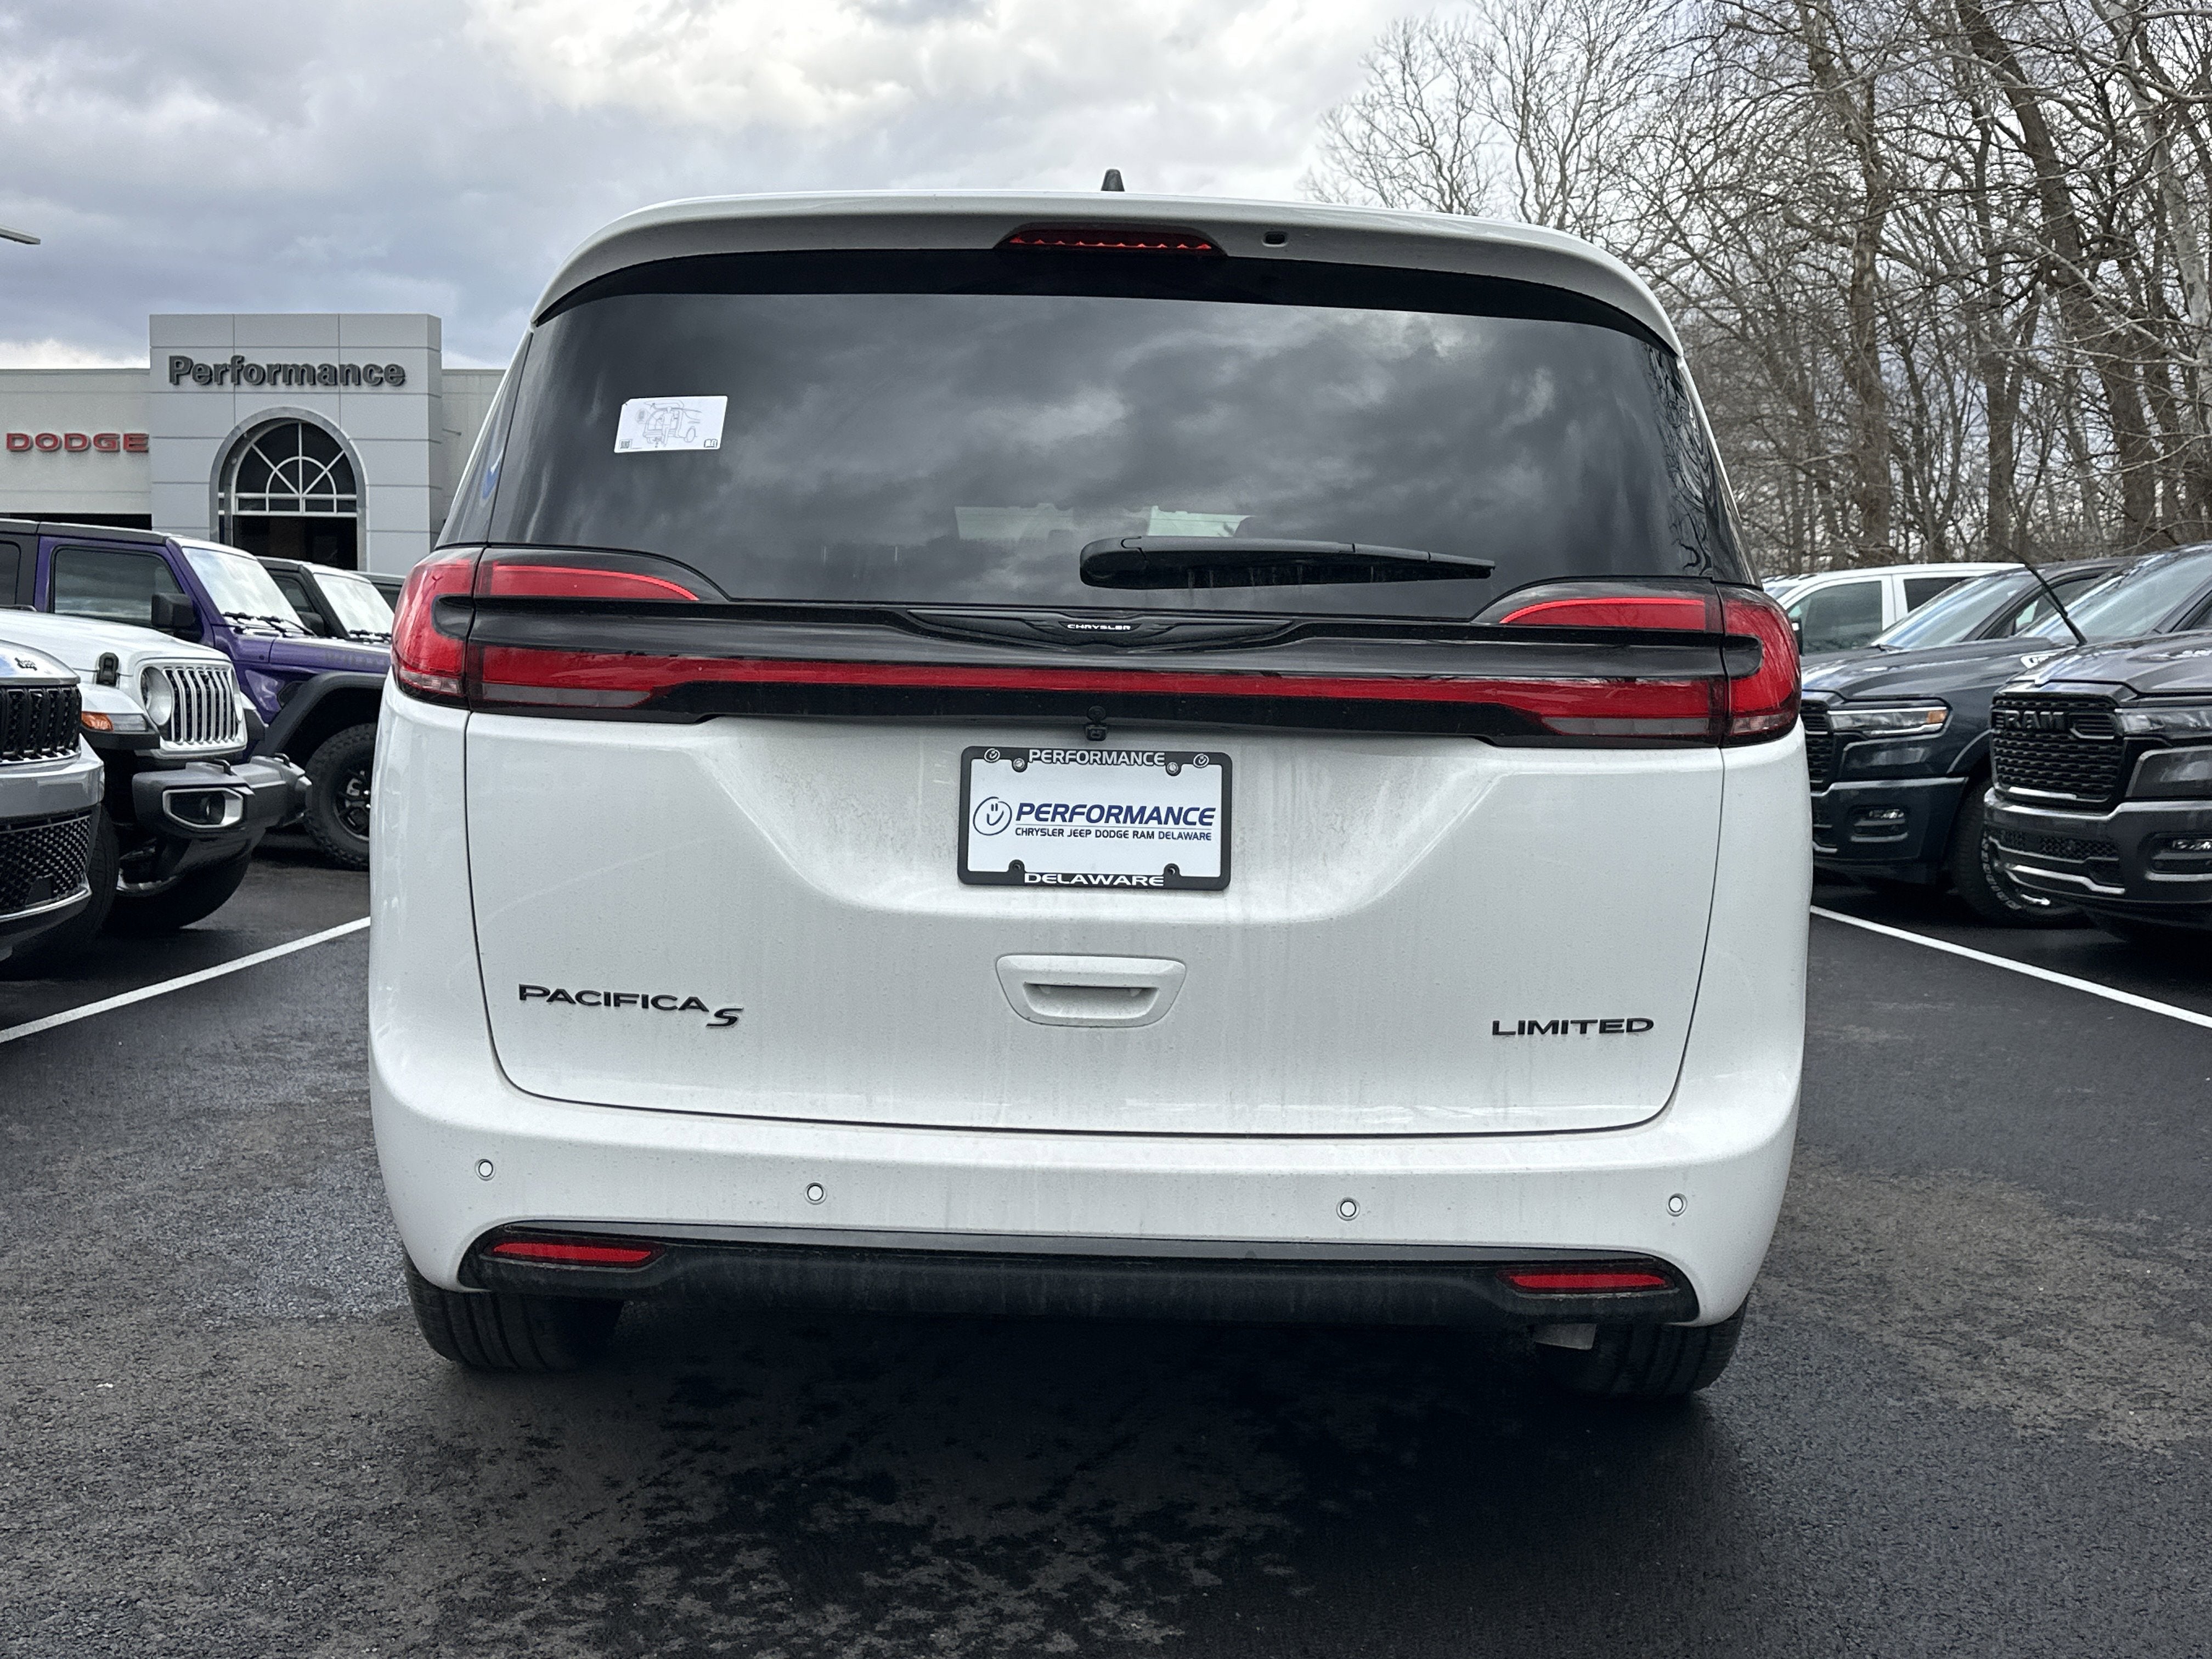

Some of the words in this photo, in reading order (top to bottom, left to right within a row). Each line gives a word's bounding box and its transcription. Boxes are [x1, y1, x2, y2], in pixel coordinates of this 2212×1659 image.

[168, 354, 406, 386] Performance
[6, 432, 149, 453] DODGE
[2005, 709, 2066, 731] RAM
[1028, 749, 1166, 766] PERFORMANCE
[1015, 802, 1216, 826] PERFORMANCE
[1015, 827, 1064, 838] CHRYSLER
[1066, 828, 1092, 838] JEEP
[1094, 829, 1130, 839] DODGE
[1132, 831, 1155, 840] RAM
[1158, 831, 1212, 842] DELAWARE
[1024, 872, 1164, 887] DELAWARE
[518, 983, 709, 1013] PACIFICA
[705, 1006, 744, 1028] S
[1492, 1018, 1655, 1036] LIMITED
